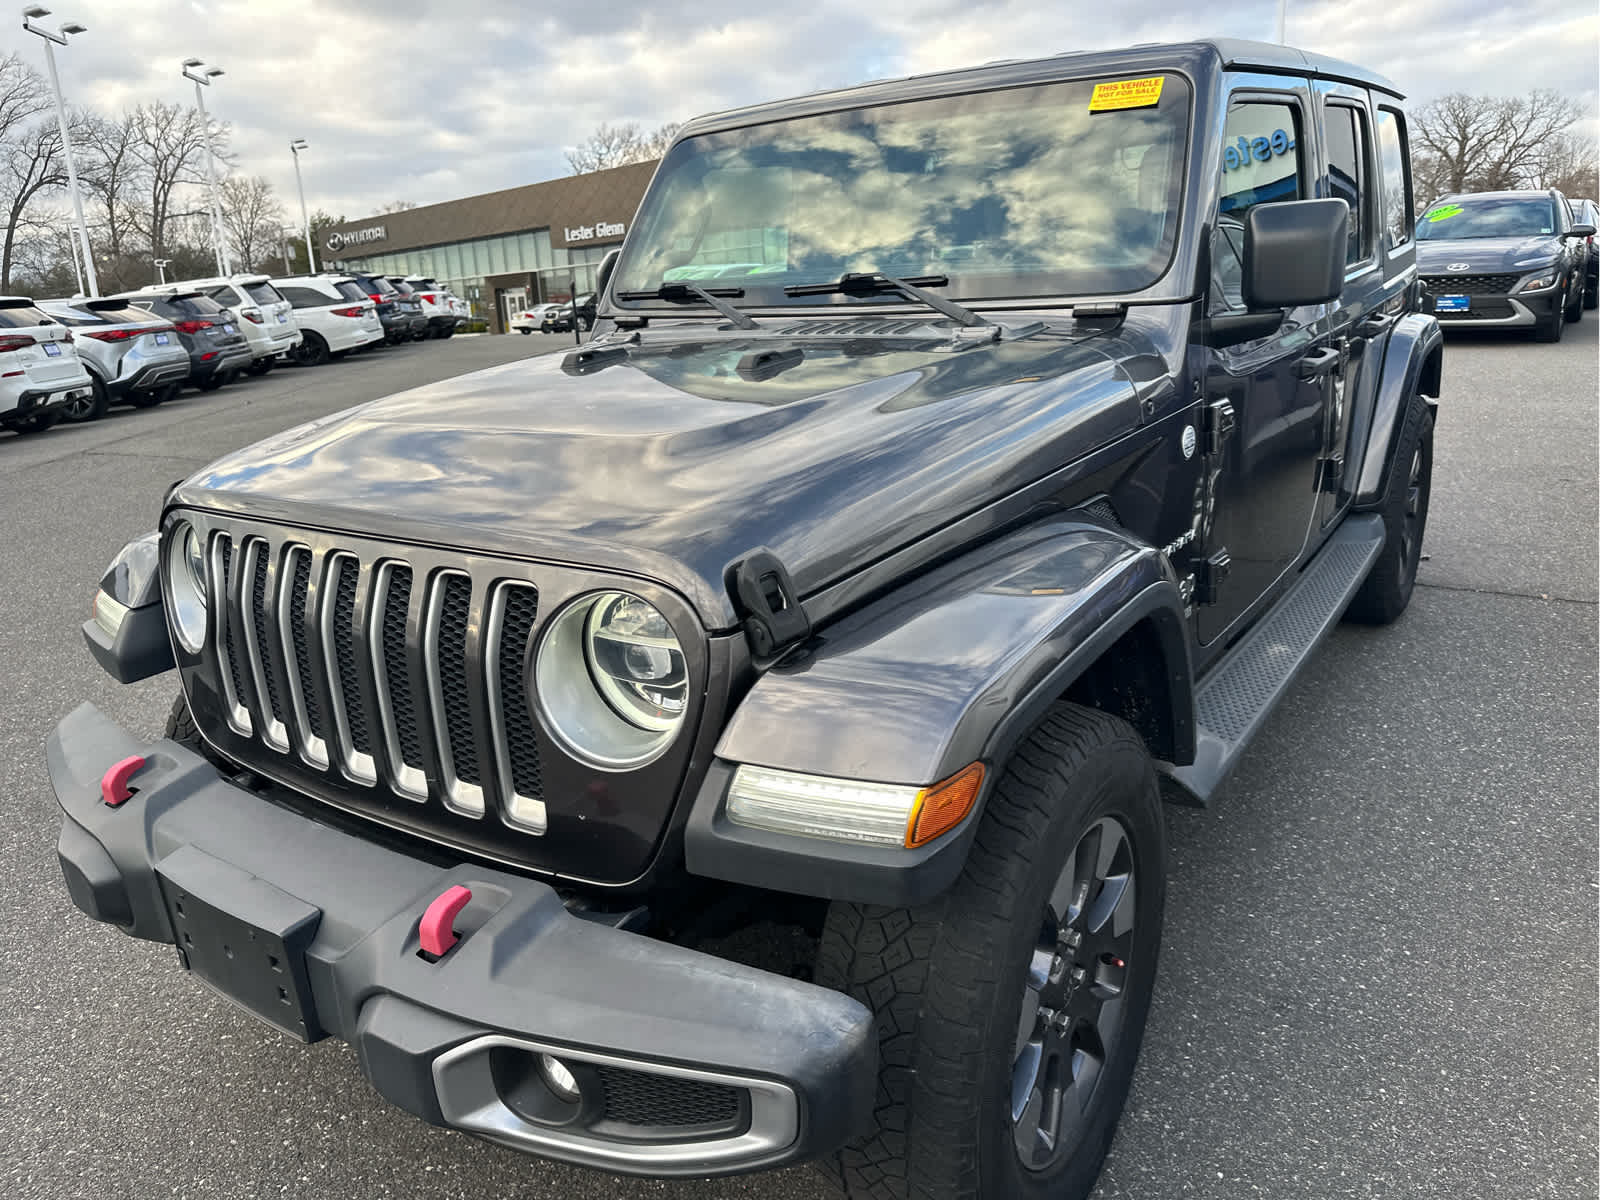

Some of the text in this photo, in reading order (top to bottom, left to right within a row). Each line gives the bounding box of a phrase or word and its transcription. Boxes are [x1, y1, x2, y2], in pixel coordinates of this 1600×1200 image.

[1098, 79, 1160, 92] THIS VEHICLE
[1116, 89, 1133, 97] FOR
[1136, 87, 1157, 95] SALE
[343, 226, 385, 244] HYUNDAI
[564, 221, 624, 242] Lester Glenn
